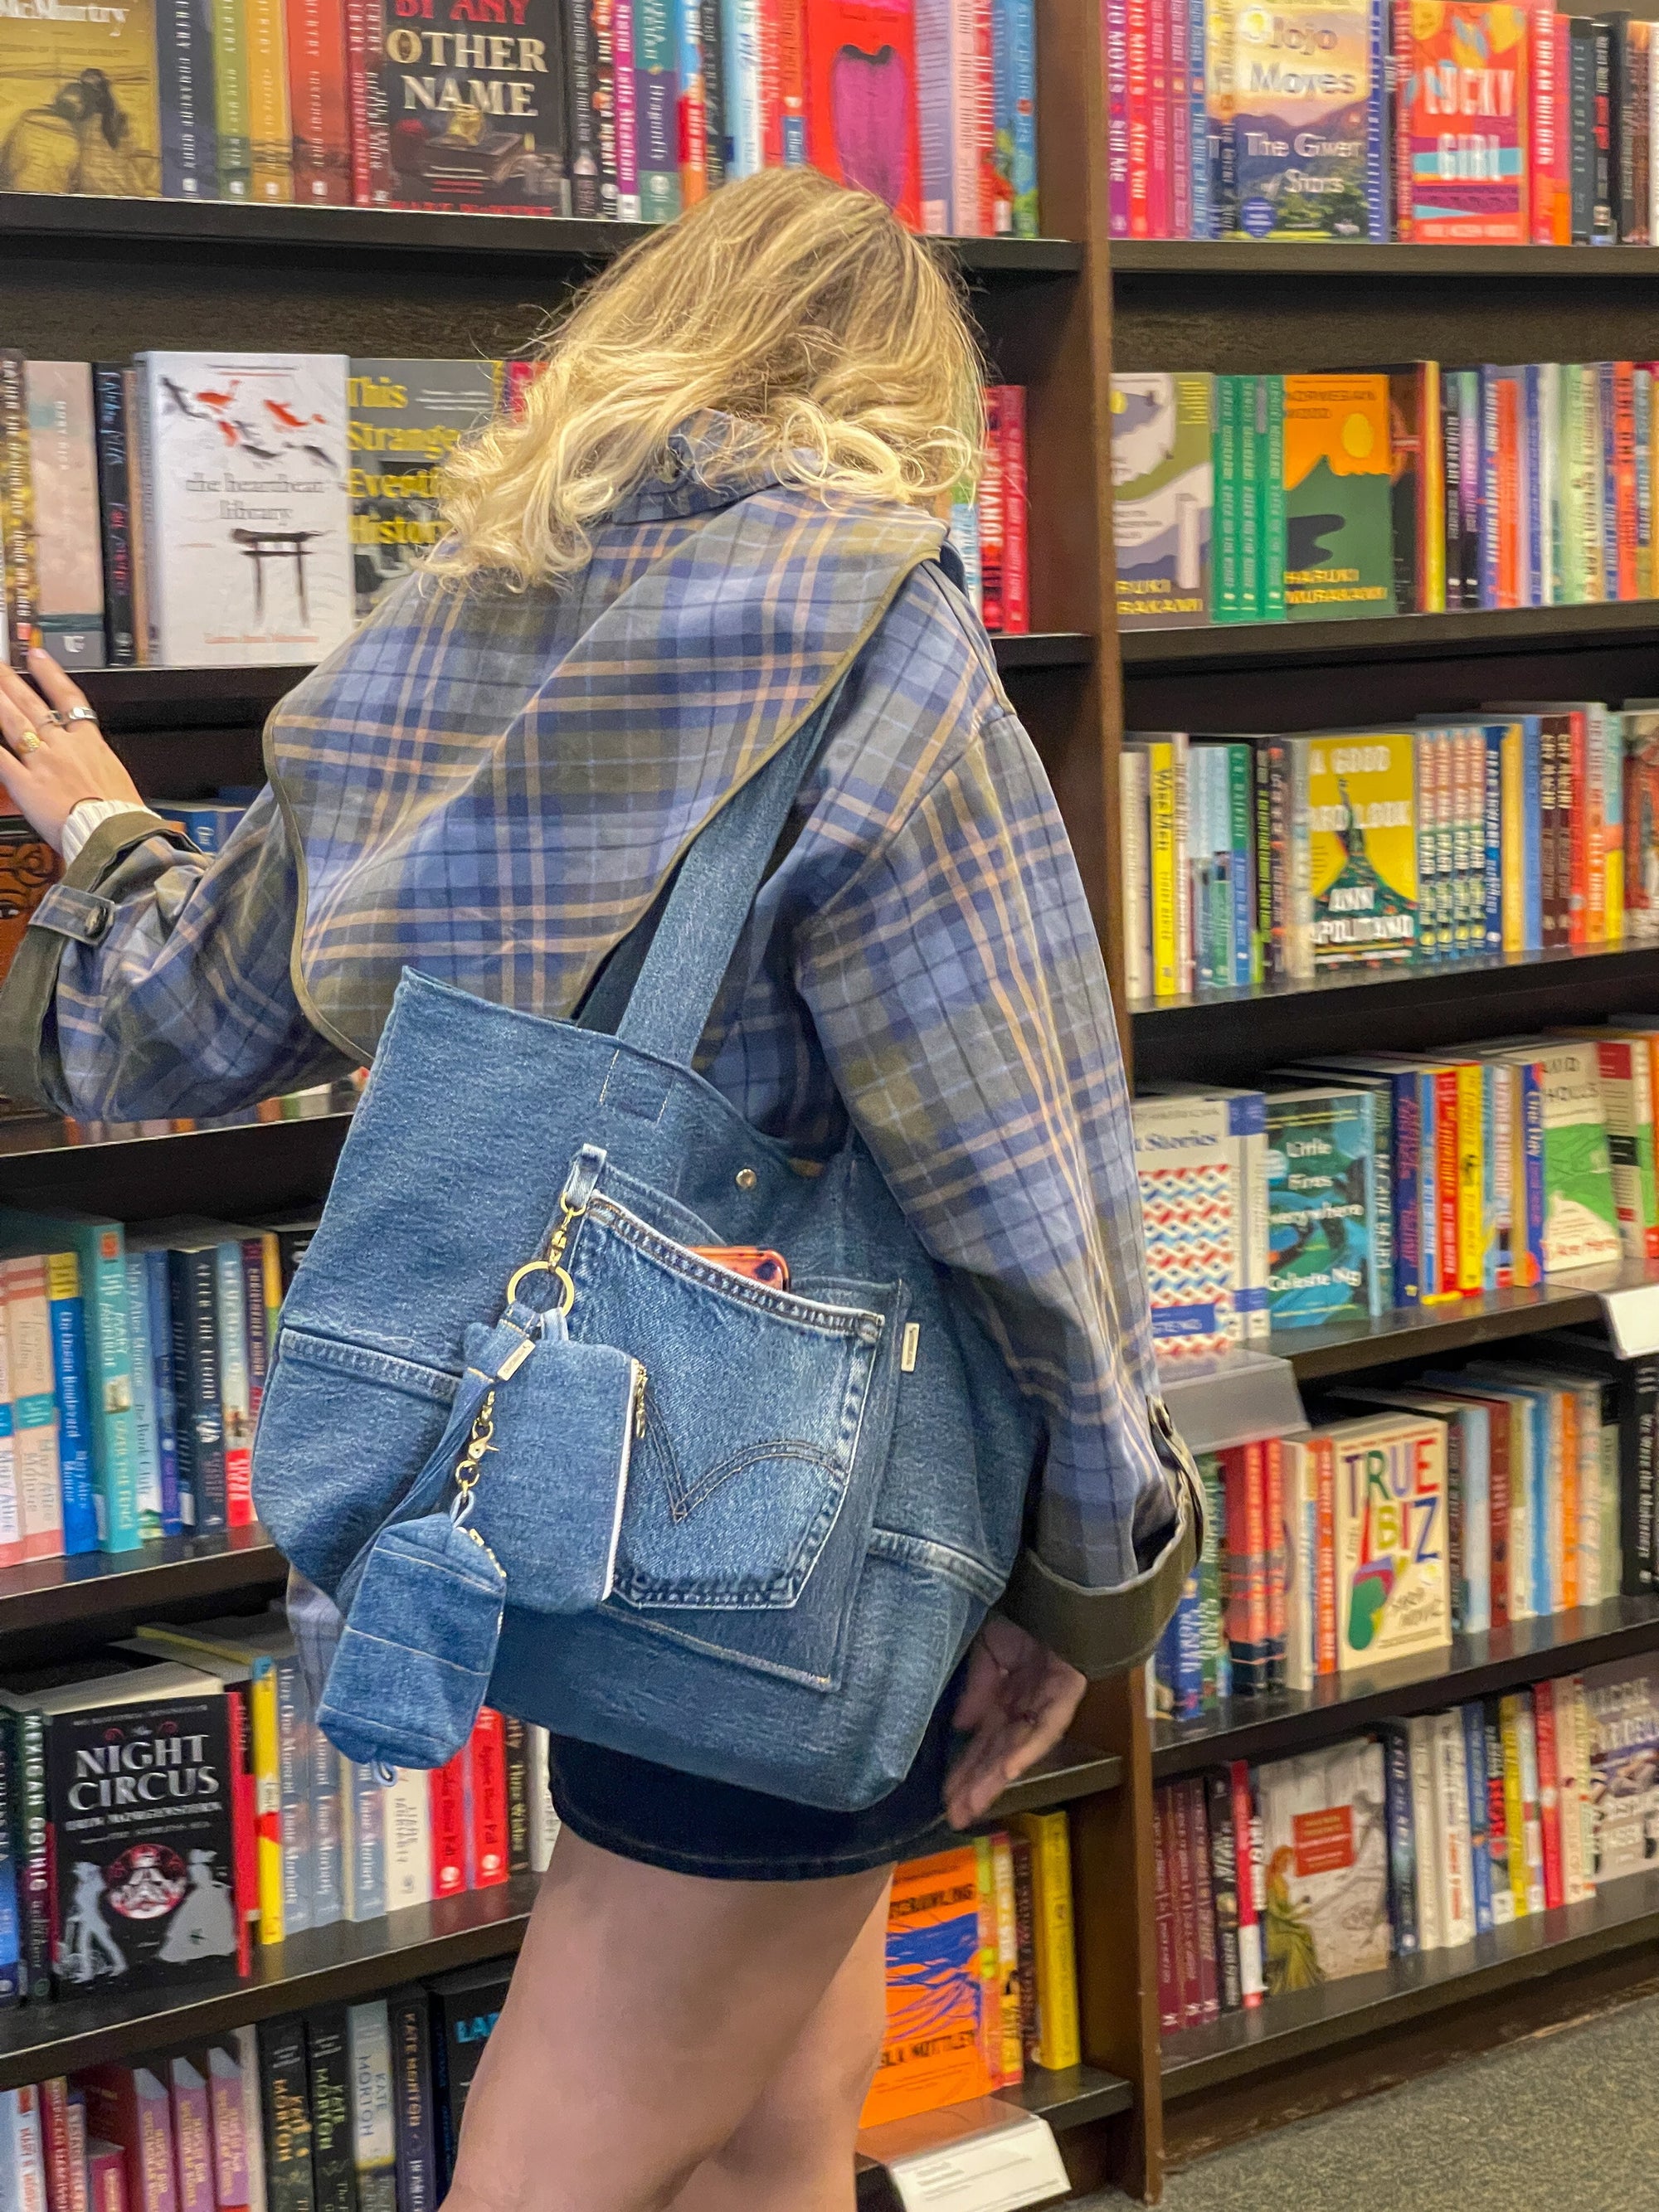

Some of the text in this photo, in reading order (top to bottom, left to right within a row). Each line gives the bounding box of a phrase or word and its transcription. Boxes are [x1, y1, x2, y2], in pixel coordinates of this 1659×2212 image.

[449, 0, 532, 25] ANY
[386, 29, 551, 74] OTHER
[1268, 17, 1338, 56] Jojo
[400, 75, 540, 118] NAME
[1249, 61, 1356, 96] Moyes
[1109, 32, 1128, 182] MOYES Still Me
[1131, 123, 1148, 163] After
[1131, 171, 1148, 200] You
[348, 377, 409, 409] This
[1331, 746, 1391, 775] GOOD
[1355, 800, 1412, 829] LOOK
[224, 1260, 237, 1285] Let
[127, 1262, 147, 1388] Mary Alice Monroe
[195, 1262, 216, 1400] AFTER THE FLOOD
[227, 1311, 242, 1357] March
[61, 1332, 75, 1373] Ocean
[62, 1375, 80, 1438] Boulevard
[1639, 1412, 1653, 1434] We
[115, 1419, 129, 1456] OVER
[1639, 1437, 1653, 1467] Were
[1339, 1437, 1440, 1519] TRUE
[1639, 1470, 1653, 1491] the
[119, 1490, 134, 1530] FENCE
[1376, 1495, 1440, 1563] BIZ
[75, 1733, 211, 1778] NIGHT
[24, 1715, 49, 1892] MEXICAN GOTHIC
[67, 1766, 220, 1811] CIRCUS
[278, 1668, 300, 1905] Here One Moment Liane Moriarty
[316, 1794, 332, 1835] Liane
[489, 1824, 499, 1845] Fall
[359, 1791, 377, 1893] Liane Moriarty
[318, 1842, 335, 1897] Moriarty
[403, 2012, 423, 2127] KATE MORTON
[314, 2067, 335, 2151] MORTON
[331, 2083, 347, 2123] KATE
[356, 2054, 376, 2137] MORTON
[375, 2072, 389, 2111] KATE
[272, 2078, 294, 2163] MORTON
[289, 2095, 313, 2134] KATE
